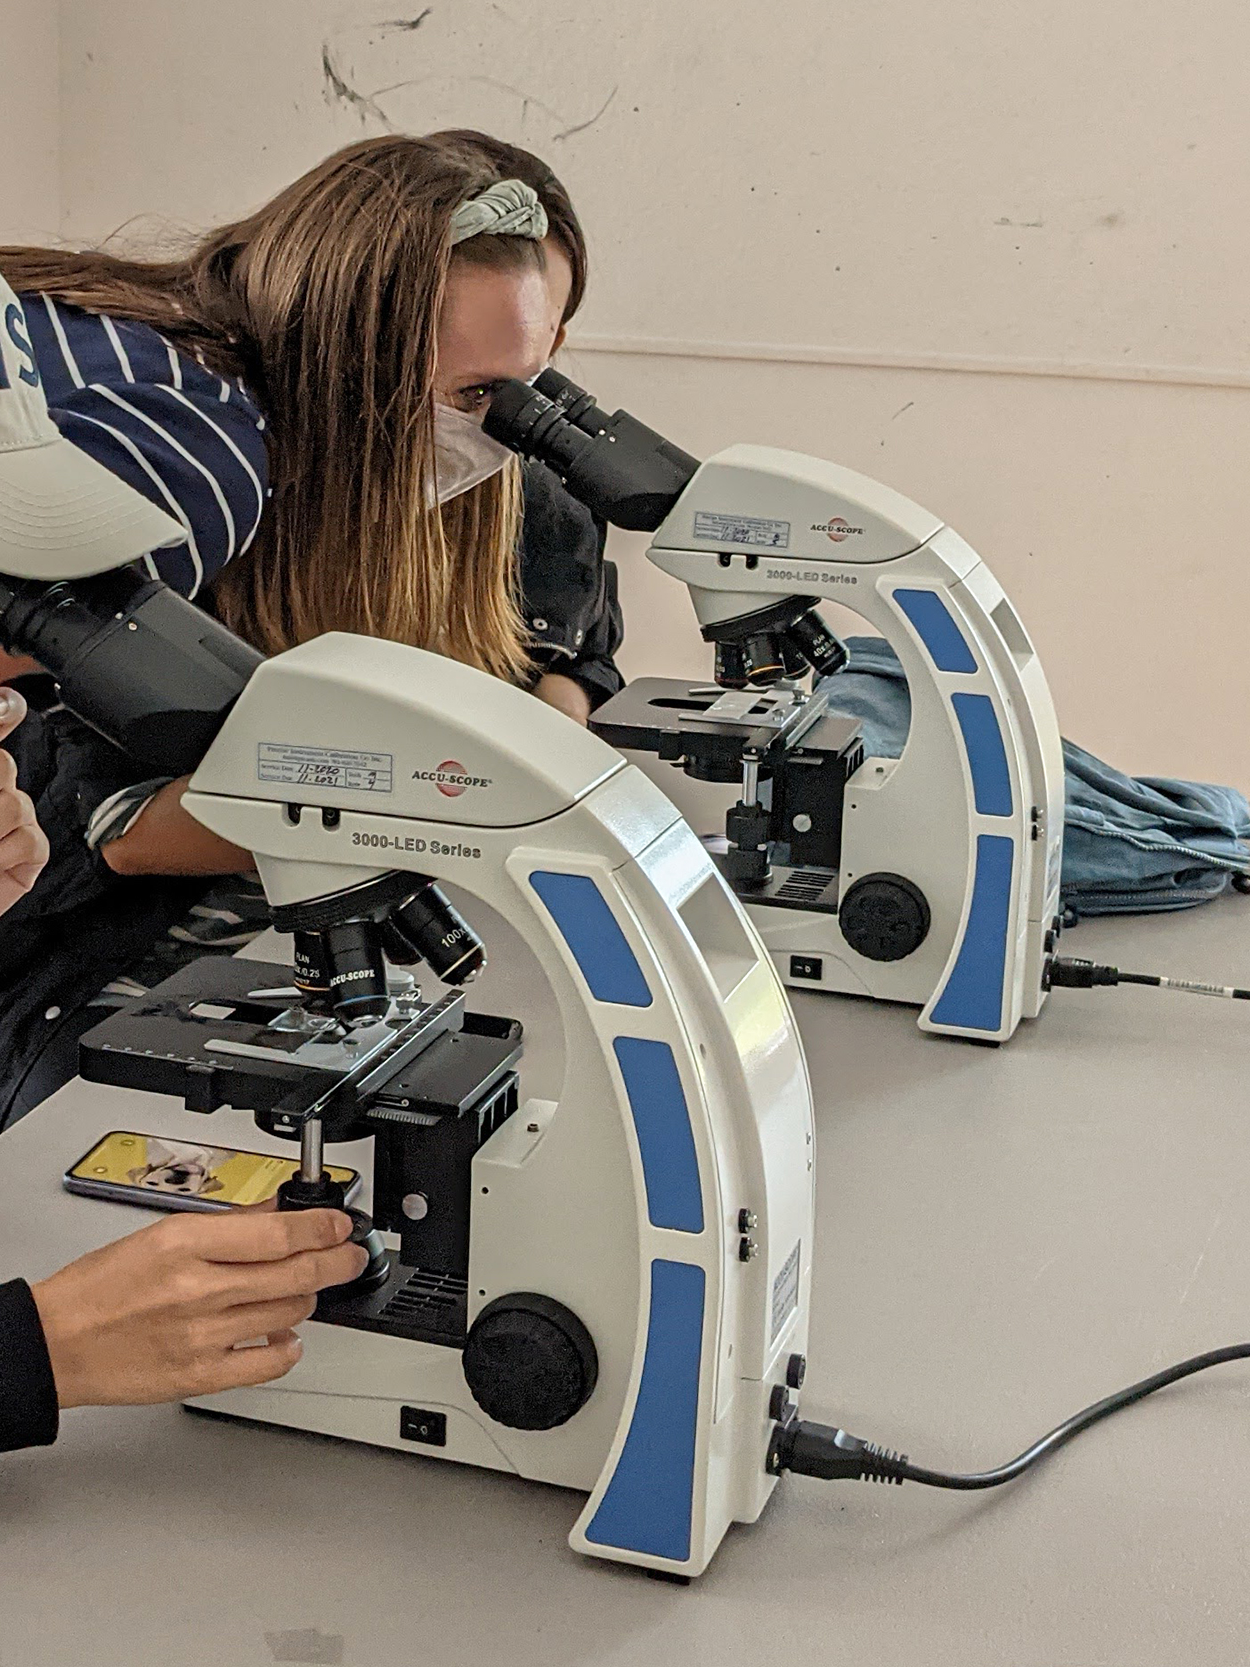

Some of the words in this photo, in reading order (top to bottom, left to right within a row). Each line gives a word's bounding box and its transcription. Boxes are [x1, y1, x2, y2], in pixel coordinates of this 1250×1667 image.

[766, 569, 819, 582] 3000-LED
[821, 573, 858, 585] Series
[352, 832, 427, 853] 3000-LED
[430, 840, 482, 859] Series
